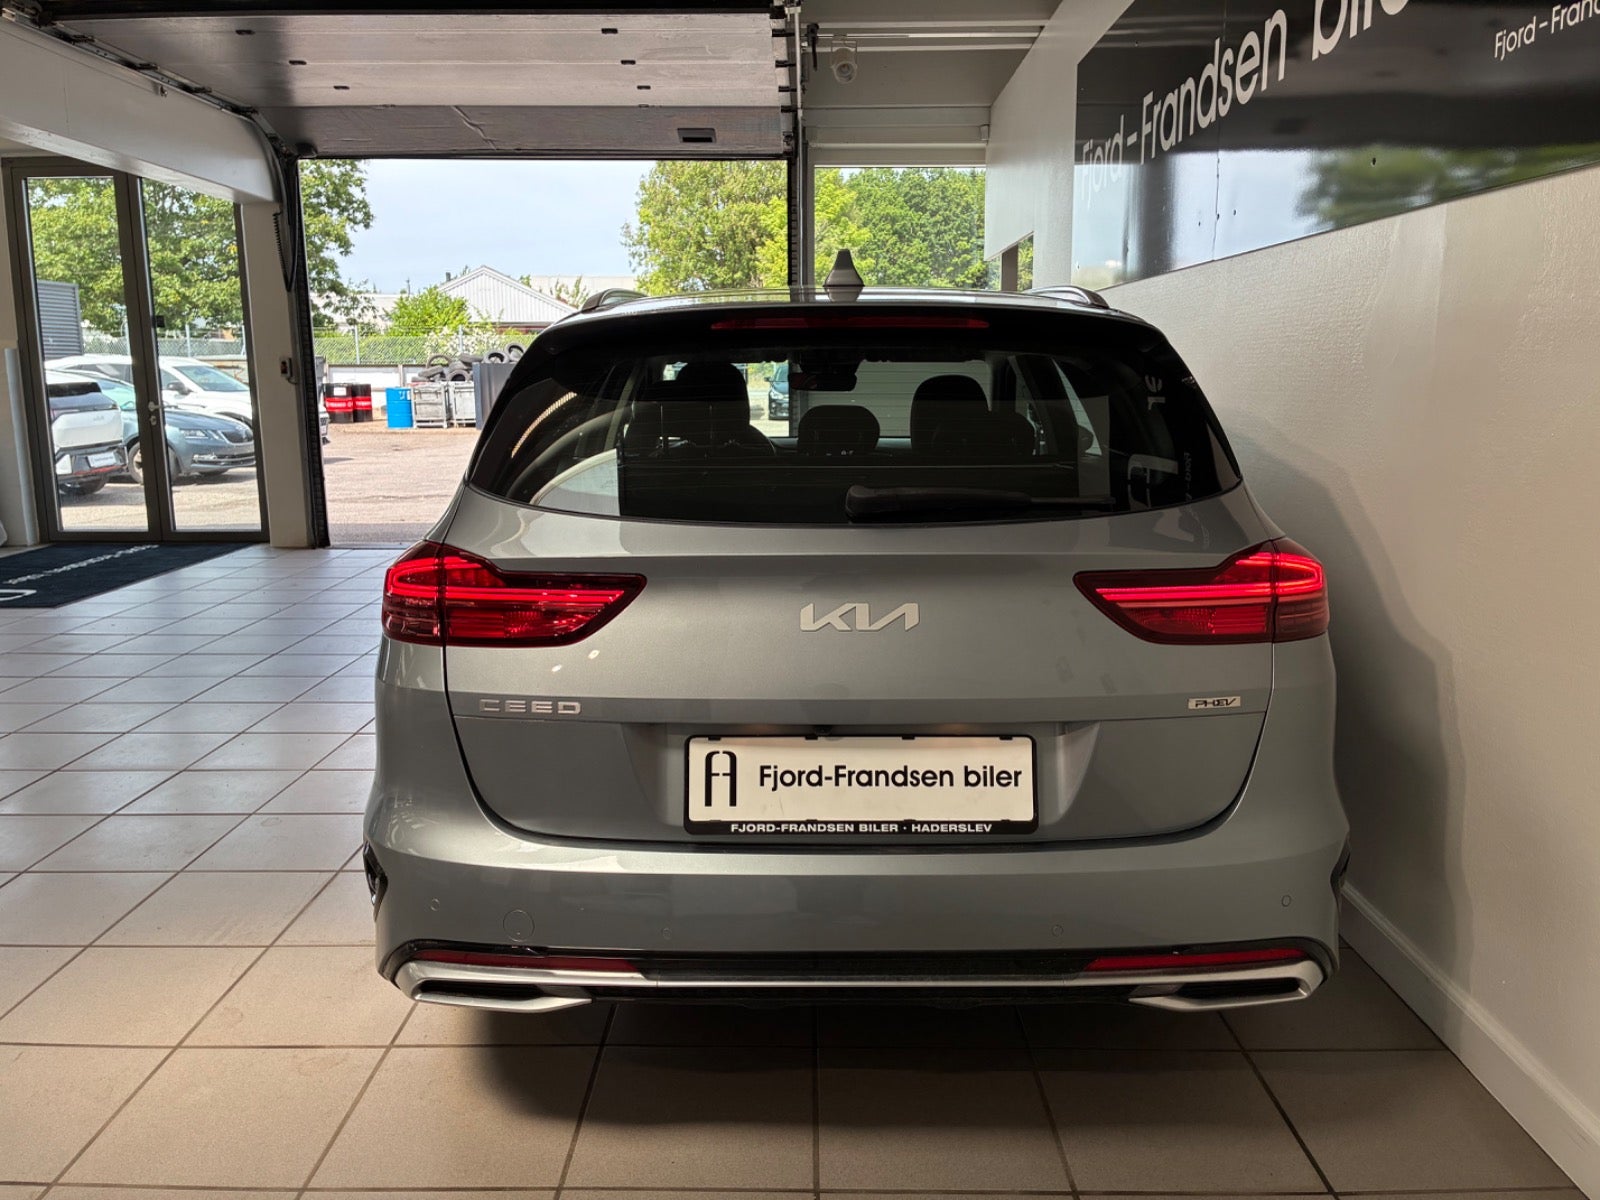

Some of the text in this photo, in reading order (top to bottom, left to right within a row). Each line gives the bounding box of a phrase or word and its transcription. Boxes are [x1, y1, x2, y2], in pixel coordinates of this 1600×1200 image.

[800, 603, 919, 631] KIA
[480, 699, 581, 714] CEED
[1193, 697, 1238, 708] PHEV
[759, 765, 1022, 791] Fjord-Frandsen biler
[731, 823, 992, 833] FJORD-FRANDSEN BILER HADERSLEV
